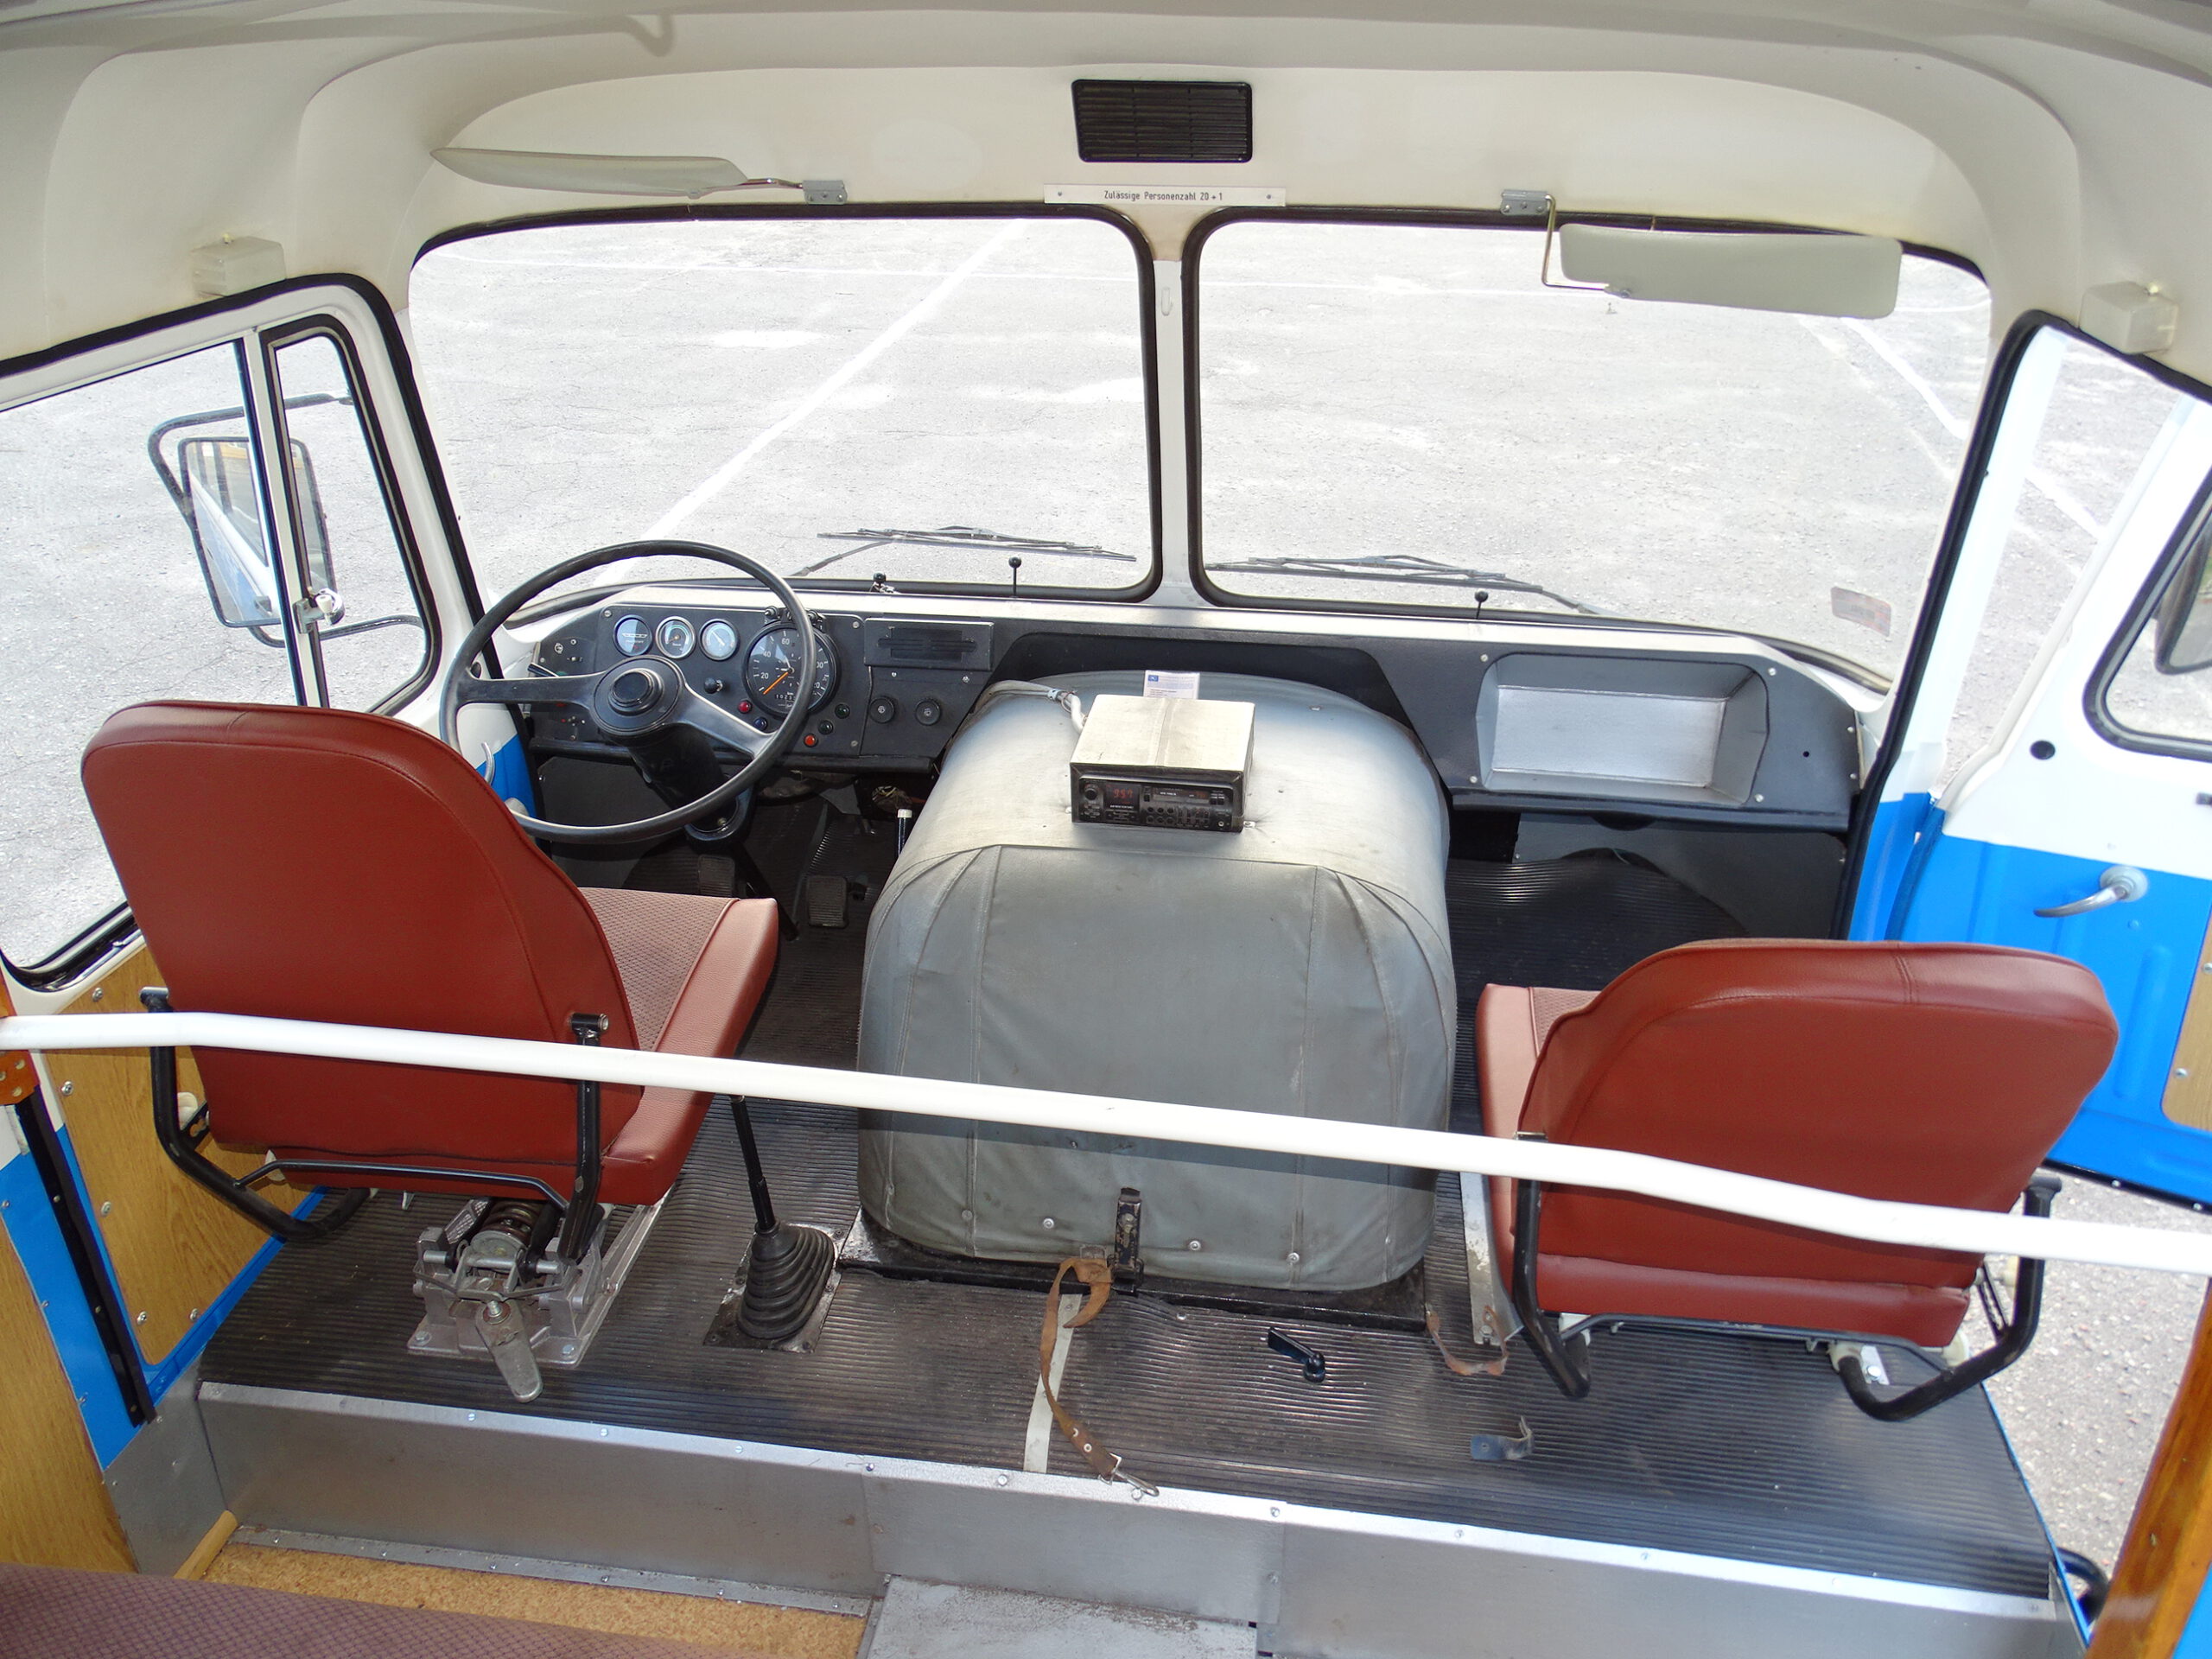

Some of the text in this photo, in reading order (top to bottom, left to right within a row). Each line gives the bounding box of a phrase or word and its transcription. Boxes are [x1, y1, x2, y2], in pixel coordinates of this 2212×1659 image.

[1104, 190, 1140, 202] Zulässige
[1144, 191, 1196, 200] Personenzahl
[1200, 192, 1209, 200] 20
